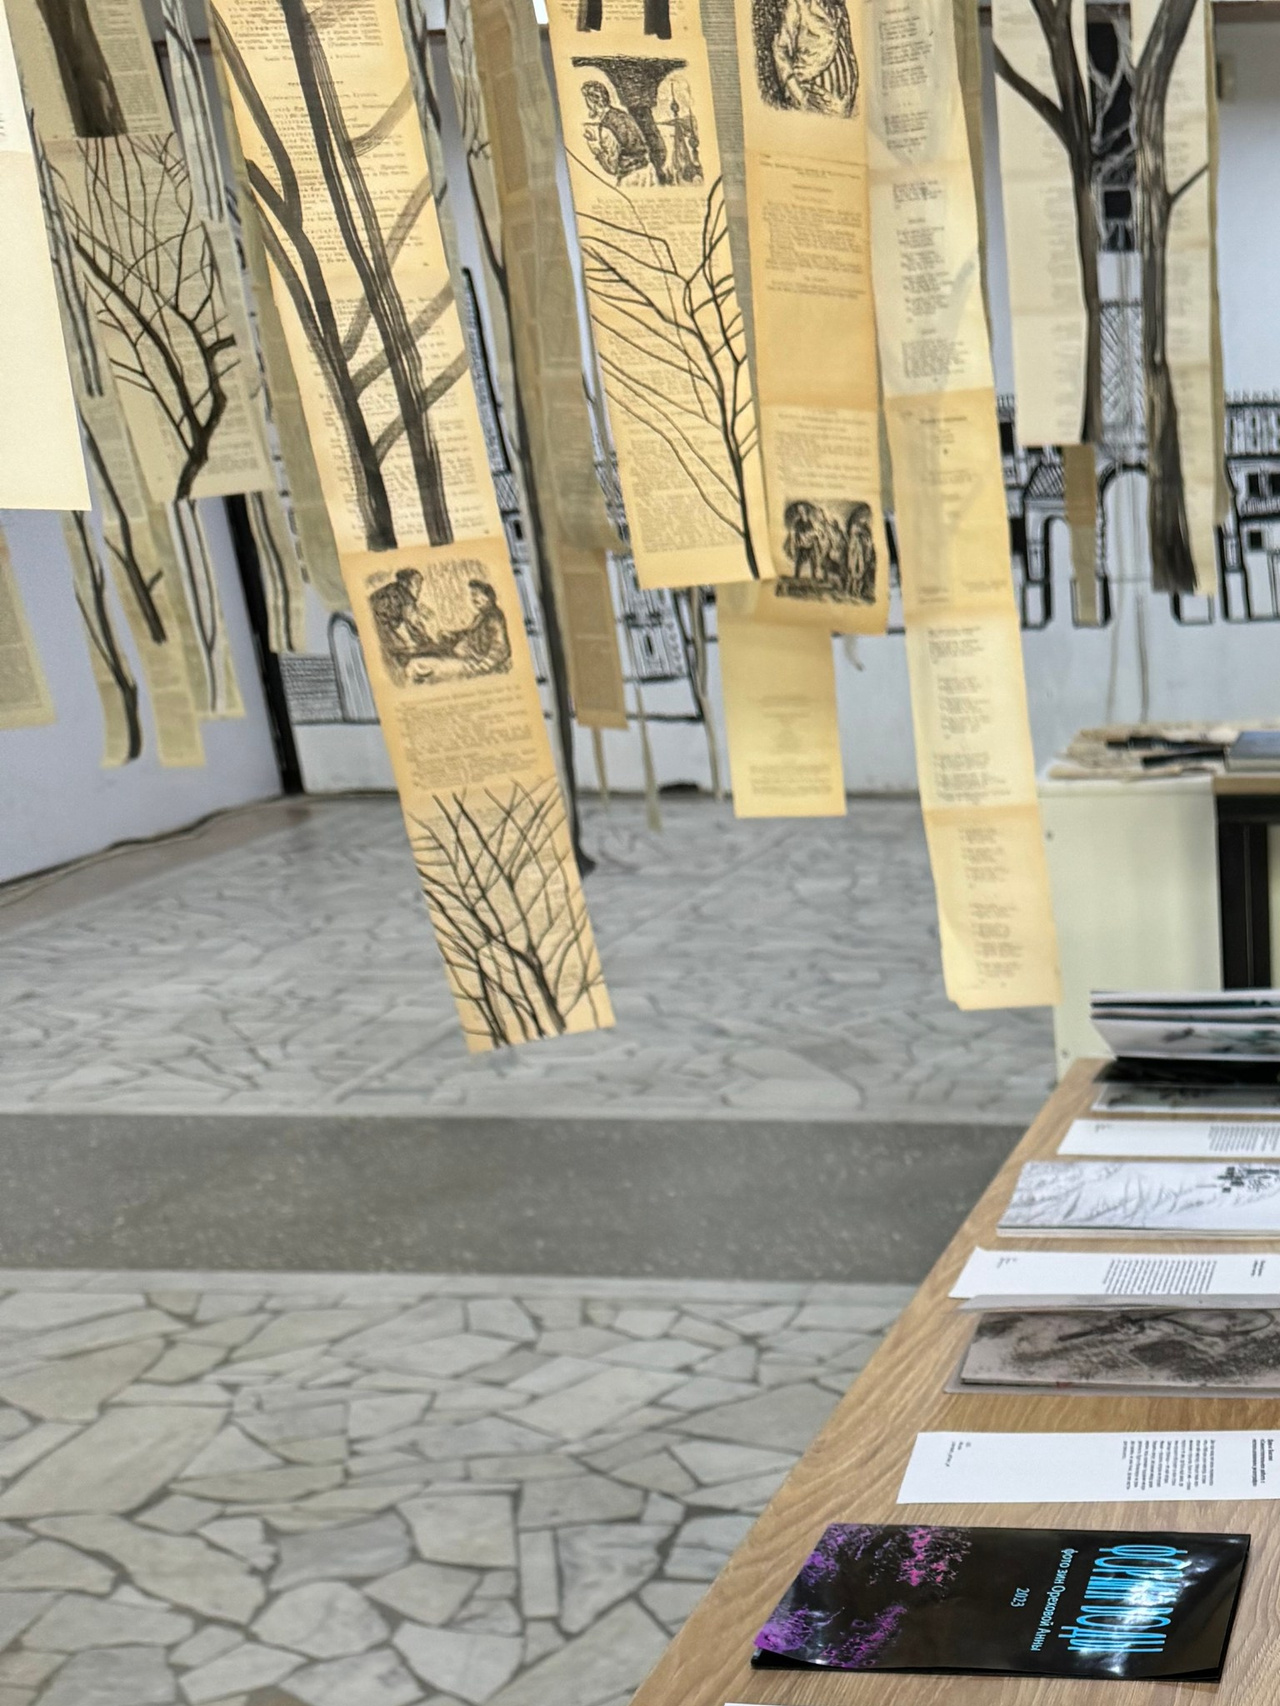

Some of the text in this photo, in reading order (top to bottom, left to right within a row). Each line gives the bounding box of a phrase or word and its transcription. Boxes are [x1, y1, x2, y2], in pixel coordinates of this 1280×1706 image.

[1010, 1587, 1030, 1608] 2023
[1031, 1548, 1078, 1651] фото зин Ореховой Анны
